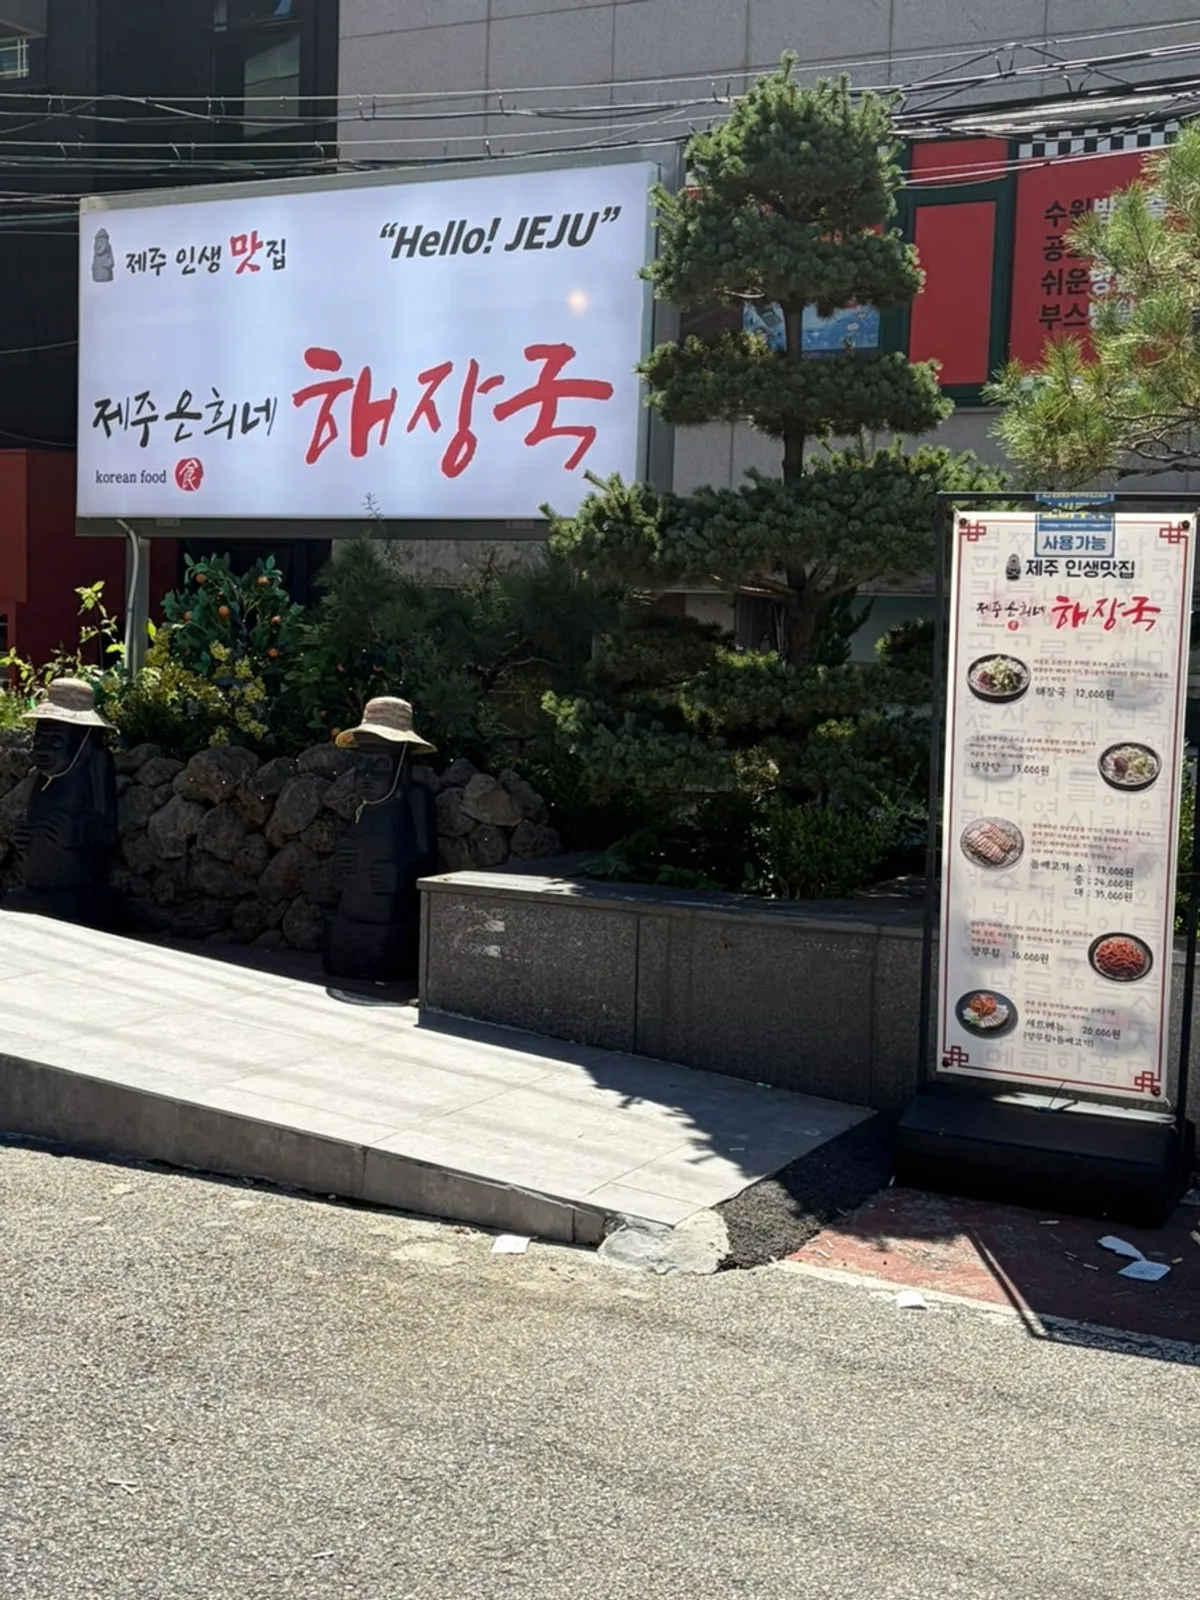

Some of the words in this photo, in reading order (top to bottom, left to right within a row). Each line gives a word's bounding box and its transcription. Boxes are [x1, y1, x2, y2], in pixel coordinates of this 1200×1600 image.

[126, 247, 167, 276] 제주
[176, 245, 221, 275] 인생
[230, 231, 286, 274] 맛집
[292, 343, 614, 479] 해장국
[95, 470, 137, 484] korean
[140, 469, 167, 484] food
[1042, 534, 1107, 552] 사용가능
[1025, 559, 1059, 577] 제주
[1065, 560, 1135, 579] 인생맛집
[1051, 595, 1161, 632] 해장국
[1035, 686, 1067, 698] 해장국
[1074, 887, 1084, 897] 대
[1026, 1019, 1065, 1032] 세트메뉴
